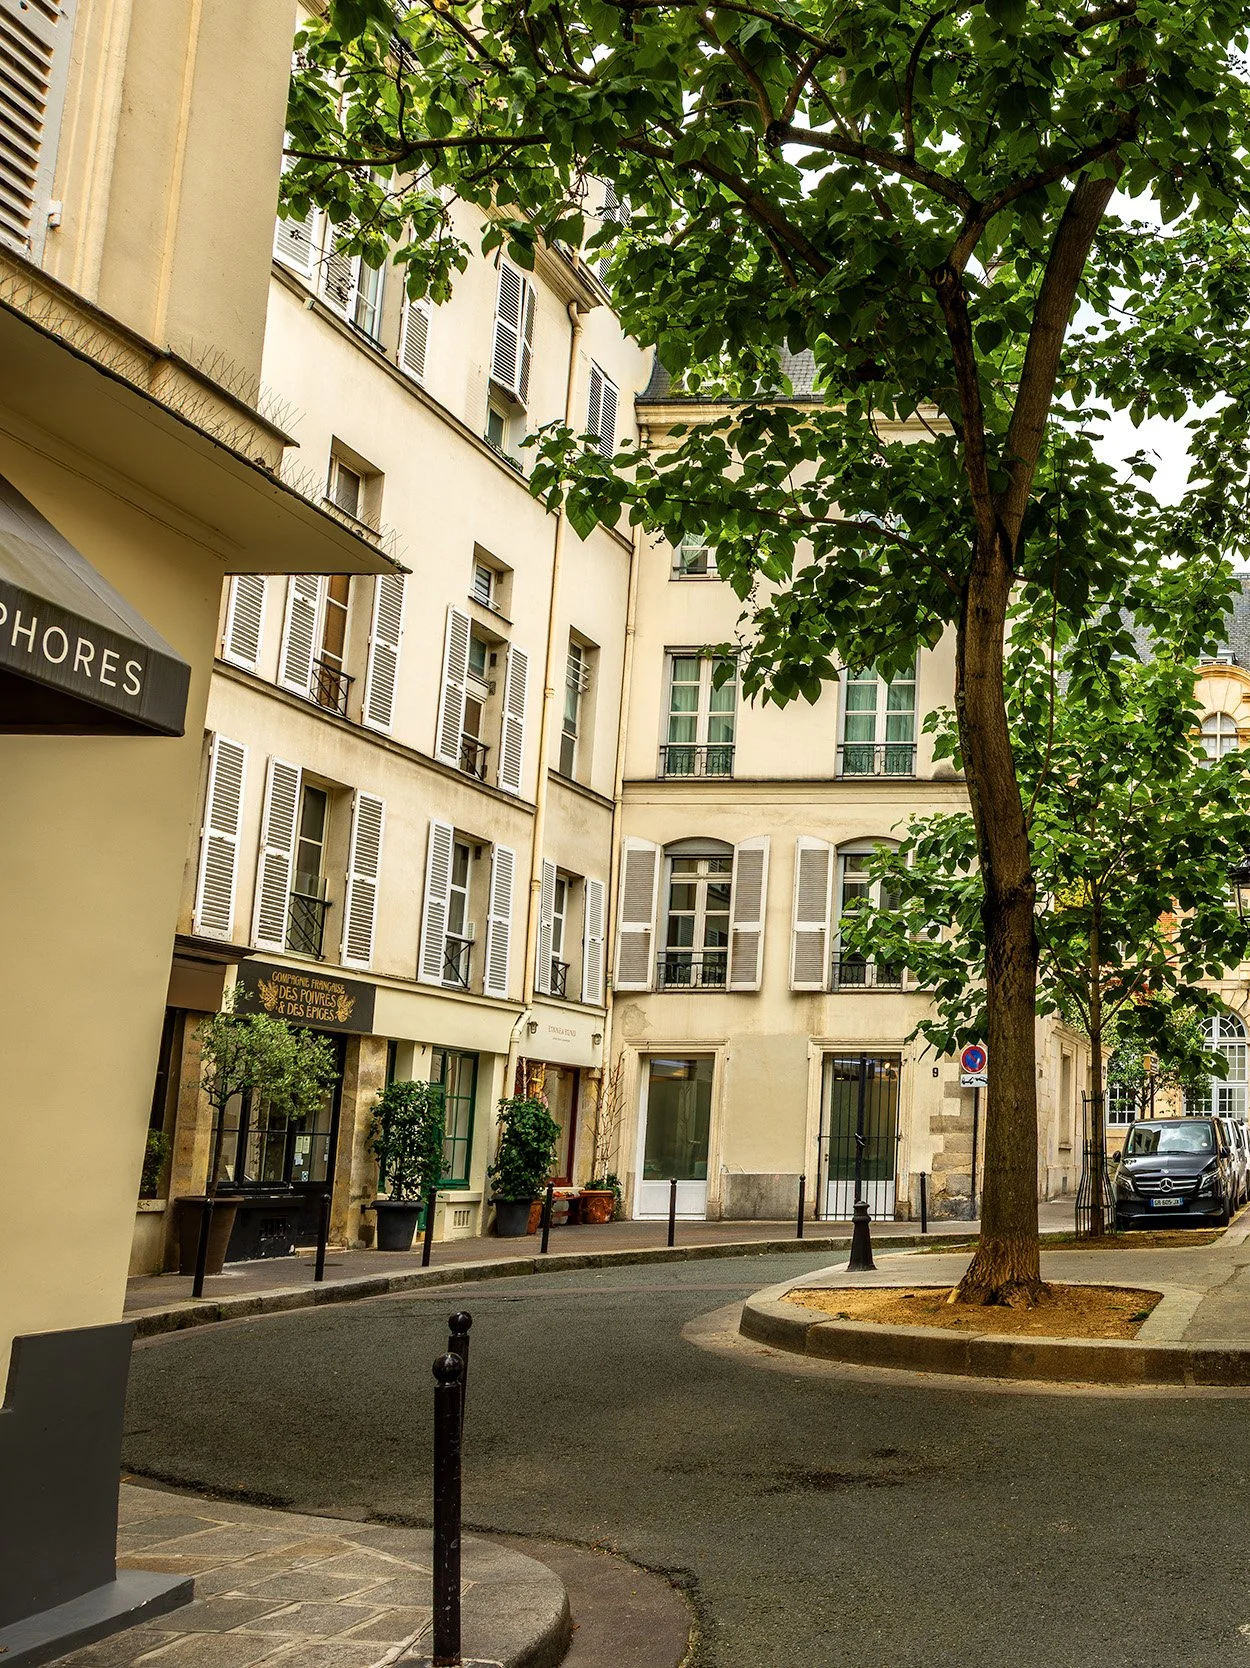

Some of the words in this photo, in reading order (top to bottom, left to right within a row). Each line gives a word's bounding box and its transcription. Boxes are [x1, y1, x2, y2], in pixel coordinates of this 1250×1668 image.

[272, 971, 310, 988] COMPAGNIE
[278, 985, 298, 1002] DES
[300, 989, 337, 1008] POIVRES
[278, 1001, 285, 1014] &
[287, 1003, 305, 1018] DES
[932, 1067, 939, 1078] 9
